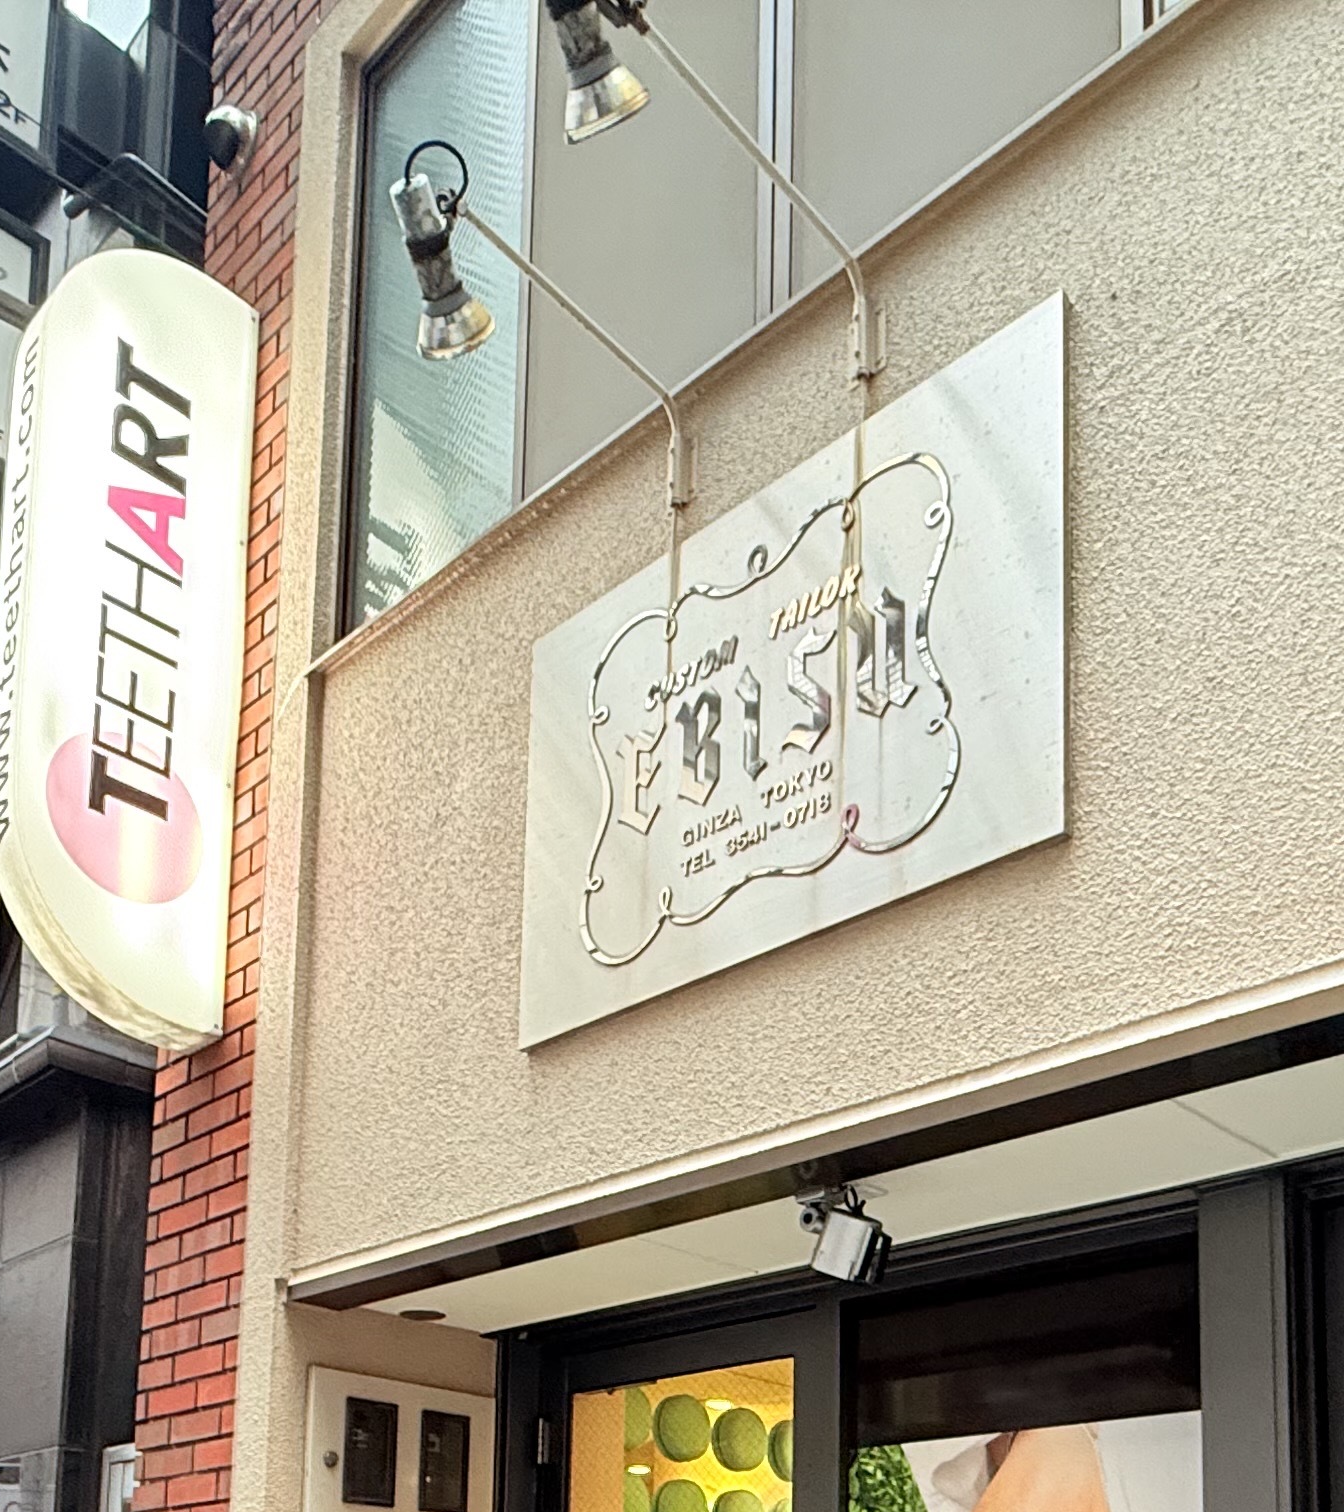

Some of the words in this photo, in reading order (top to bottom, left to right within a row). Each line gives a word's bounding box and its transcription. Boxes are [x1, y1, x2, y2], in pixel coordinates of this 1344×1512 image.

[88, 335, 192, 822] TEETHART
[644, 635, 739, 712] CUSTOM
[768, 564, 862, 640] TAILOR
[680, 805, 743, 848] GINZA
[760, 760, 833, 808] TOKYO
[680, 849, 716, 878] TEL
[725, 794, 832, 857] 3541-0718
